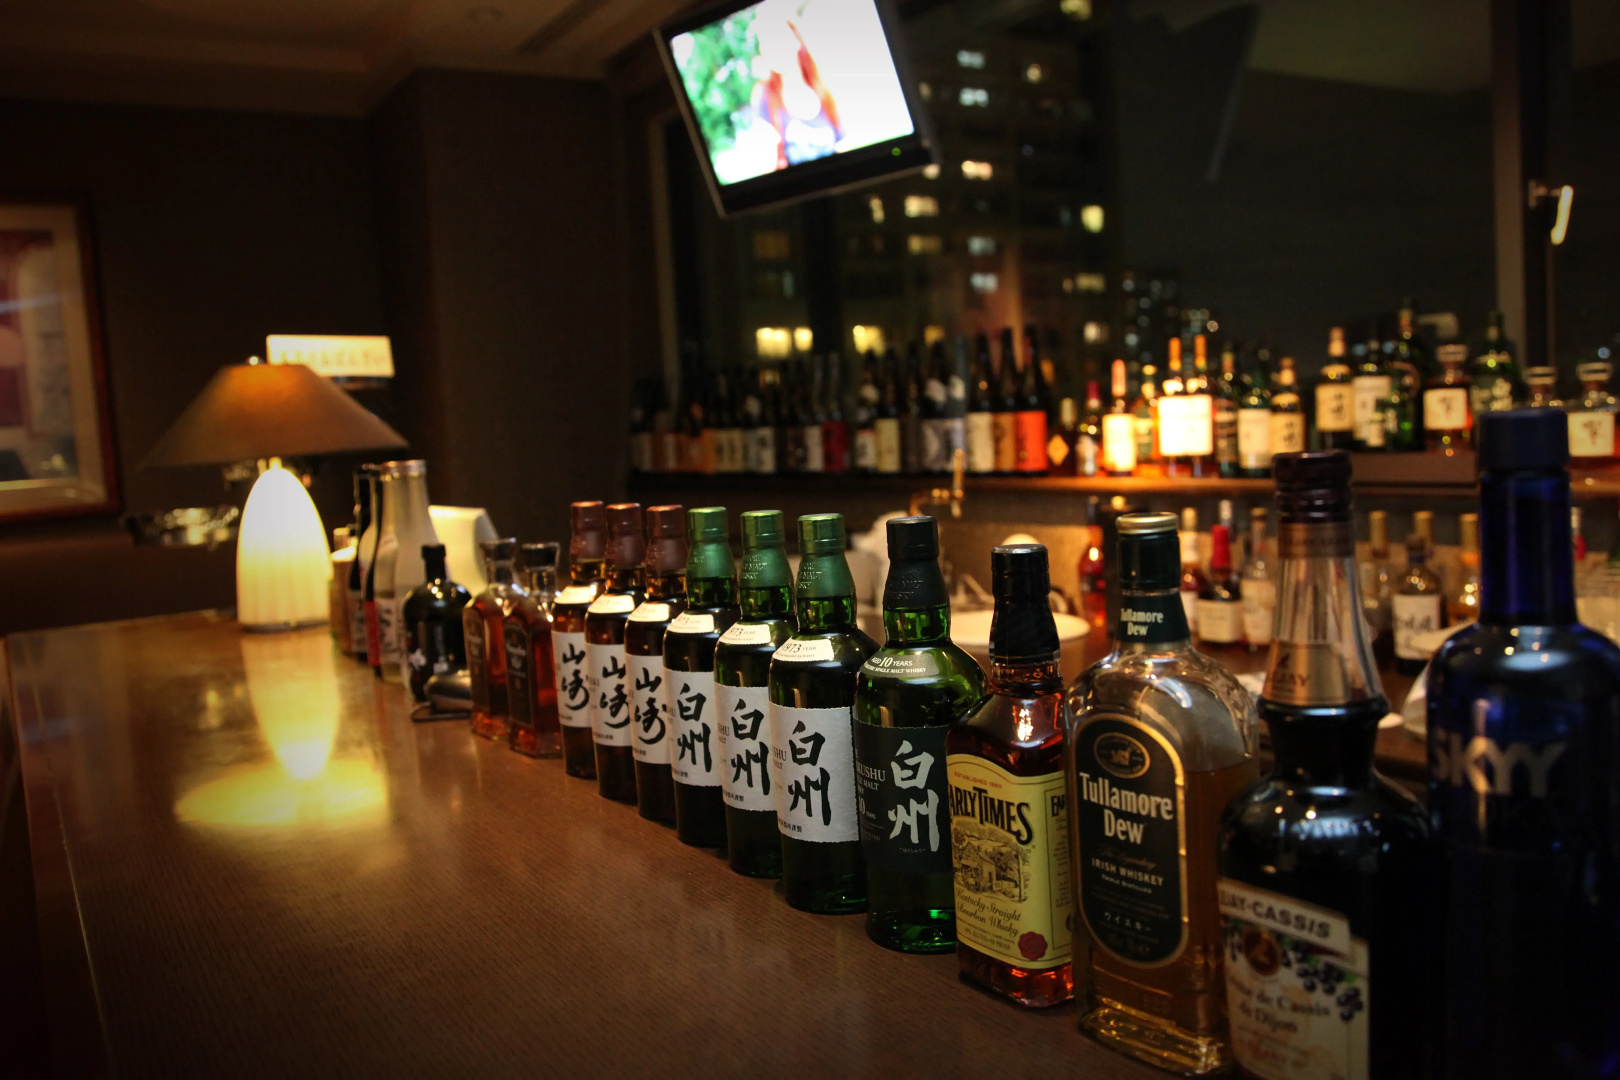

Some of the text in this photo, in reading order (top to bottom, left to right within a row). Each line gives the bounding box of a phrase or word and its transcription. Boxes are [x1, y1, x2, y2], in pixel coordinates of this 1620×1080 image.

[1120, 608, 1164, 623] Tullamore
[1127, 622, 1149, 636] Dew
[562, 643, 590, 711] 山崎
[600, 656, 631, 729] 山崎
[879, 656, 894, 667] 10
[635, 667, 666, 745] 山崎
[677, 683, 712, 773] 白州
[731, 699, 770, 796] 白州
[788, 721, 832, 827] 白州
[1432, 727, 1568, 799] SKYY
[888, 741, 940, 852] 白州
[948, 783, 977, 818] ARLY
[972, 786, 1034, 846] TIMES
[1079, 771, 1174, 821] Tullamore
[1104, 808, 1145, 845] Dew
[1091, 857, 1118, 874] IRISH
[1119, 866, 1164, 887] WHISKEY
[955, 887, 1022, 922] Kentucky Straight
[957, 902, 1019, 938] Bourbon Whisky
